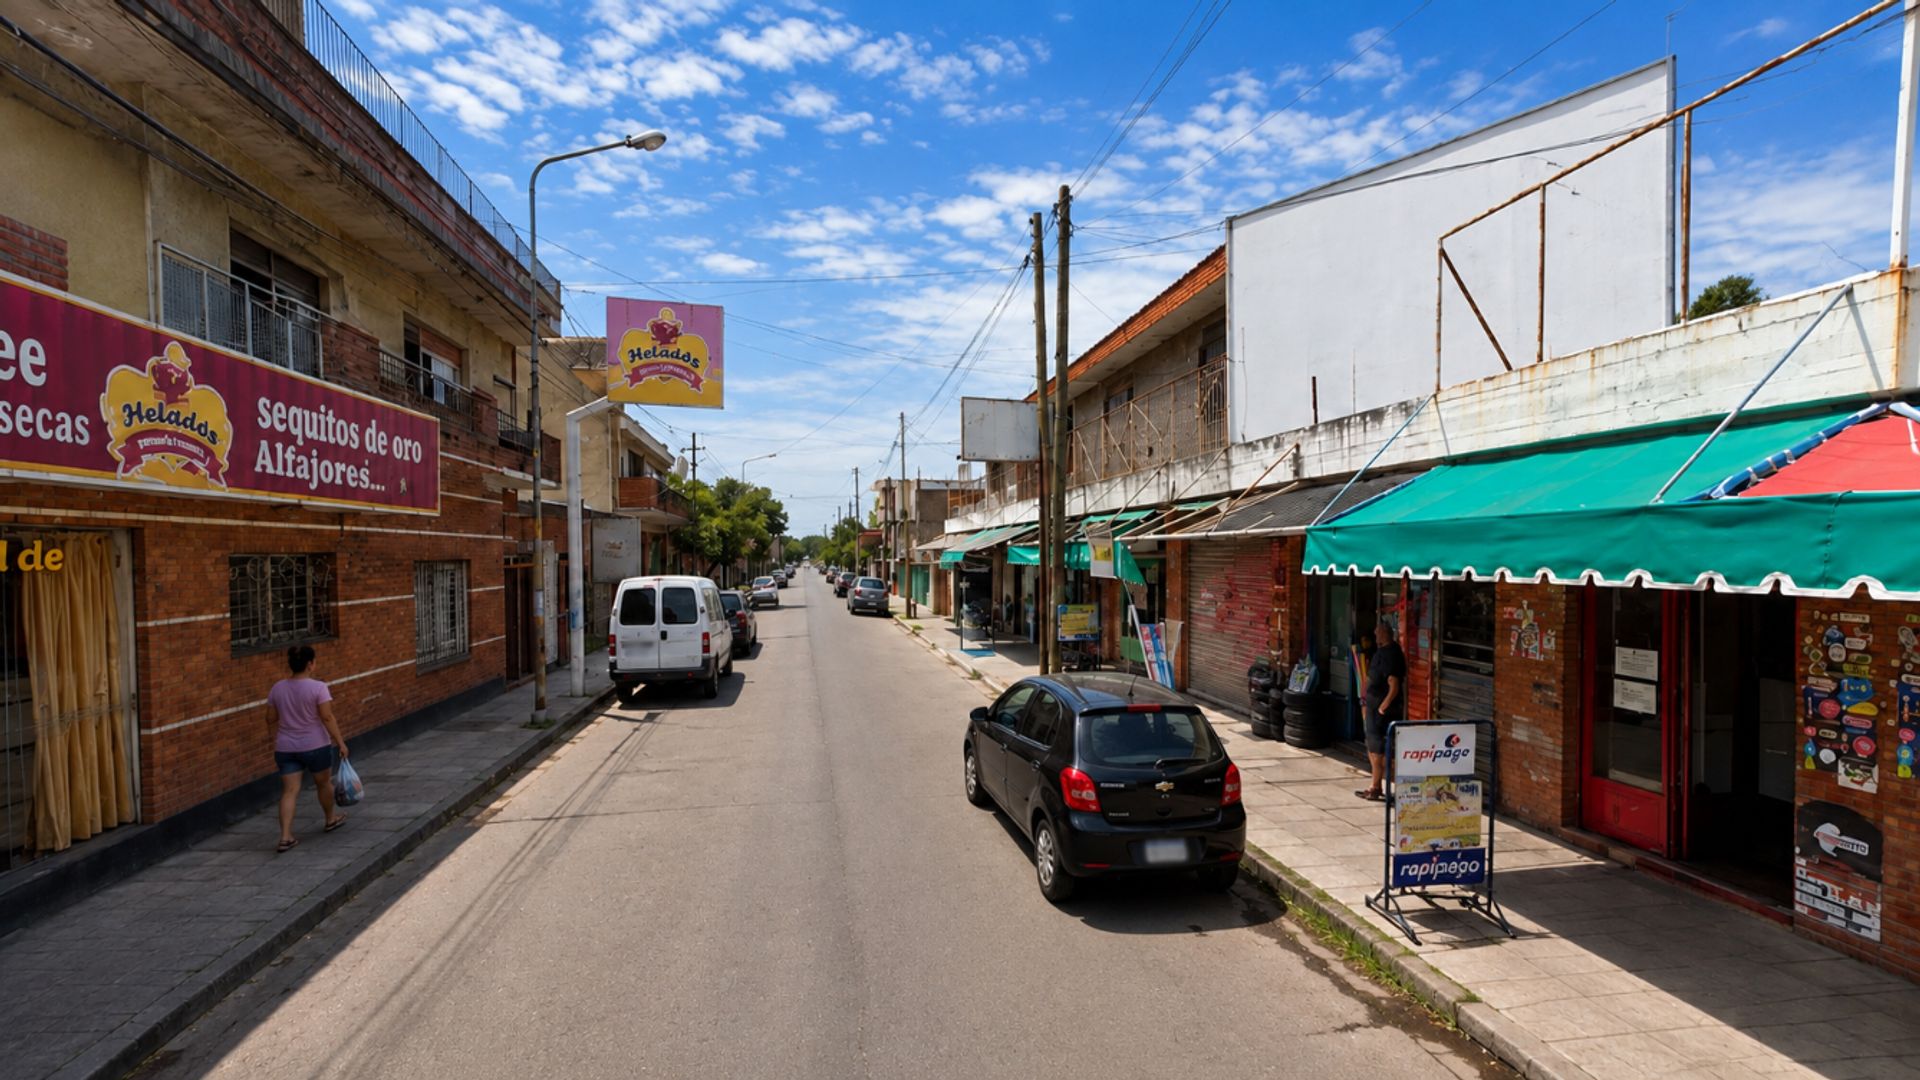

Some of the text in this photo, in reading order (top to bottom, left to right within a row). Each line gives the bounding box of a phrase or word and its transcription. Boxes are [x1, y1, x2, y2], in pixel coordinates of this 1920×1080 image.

[0, 400, 90, 446] secas
[364, 419, 388, 456] de
[392, 435, 422, 464] oro
[17, 540, 64, 572] de
